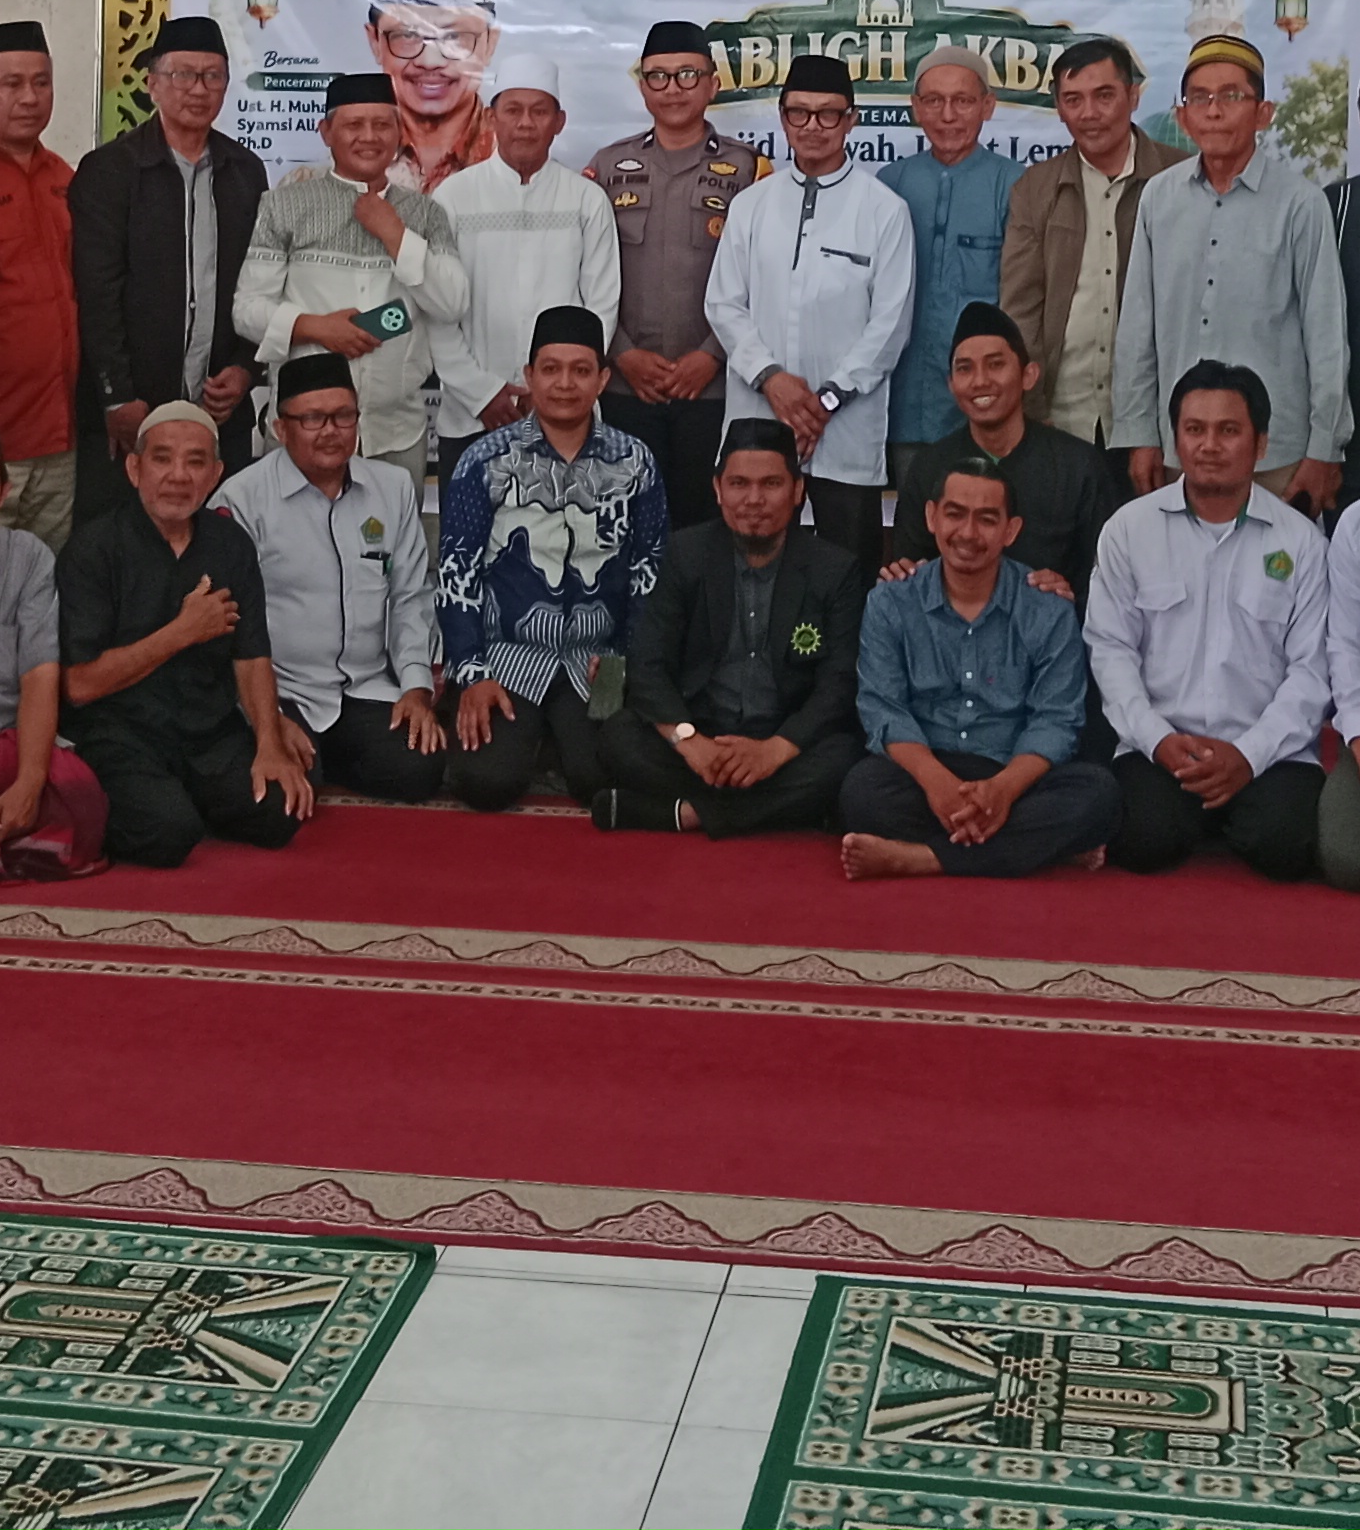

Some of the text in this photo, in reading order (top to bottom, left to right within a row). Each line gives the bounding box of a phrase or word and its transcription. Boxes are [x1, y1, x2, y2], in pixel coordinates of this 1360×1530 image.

[264, 51, 320, 68] Bersama
[264, 77, 333, 88] Pencerama
[238, 100, 327, 113] Ust. H. Muha
[858, 109, 911, 123] TEMA
[237, 119, 292, 134] Syamsi
[238, 137, 272, 150] Ph.D
